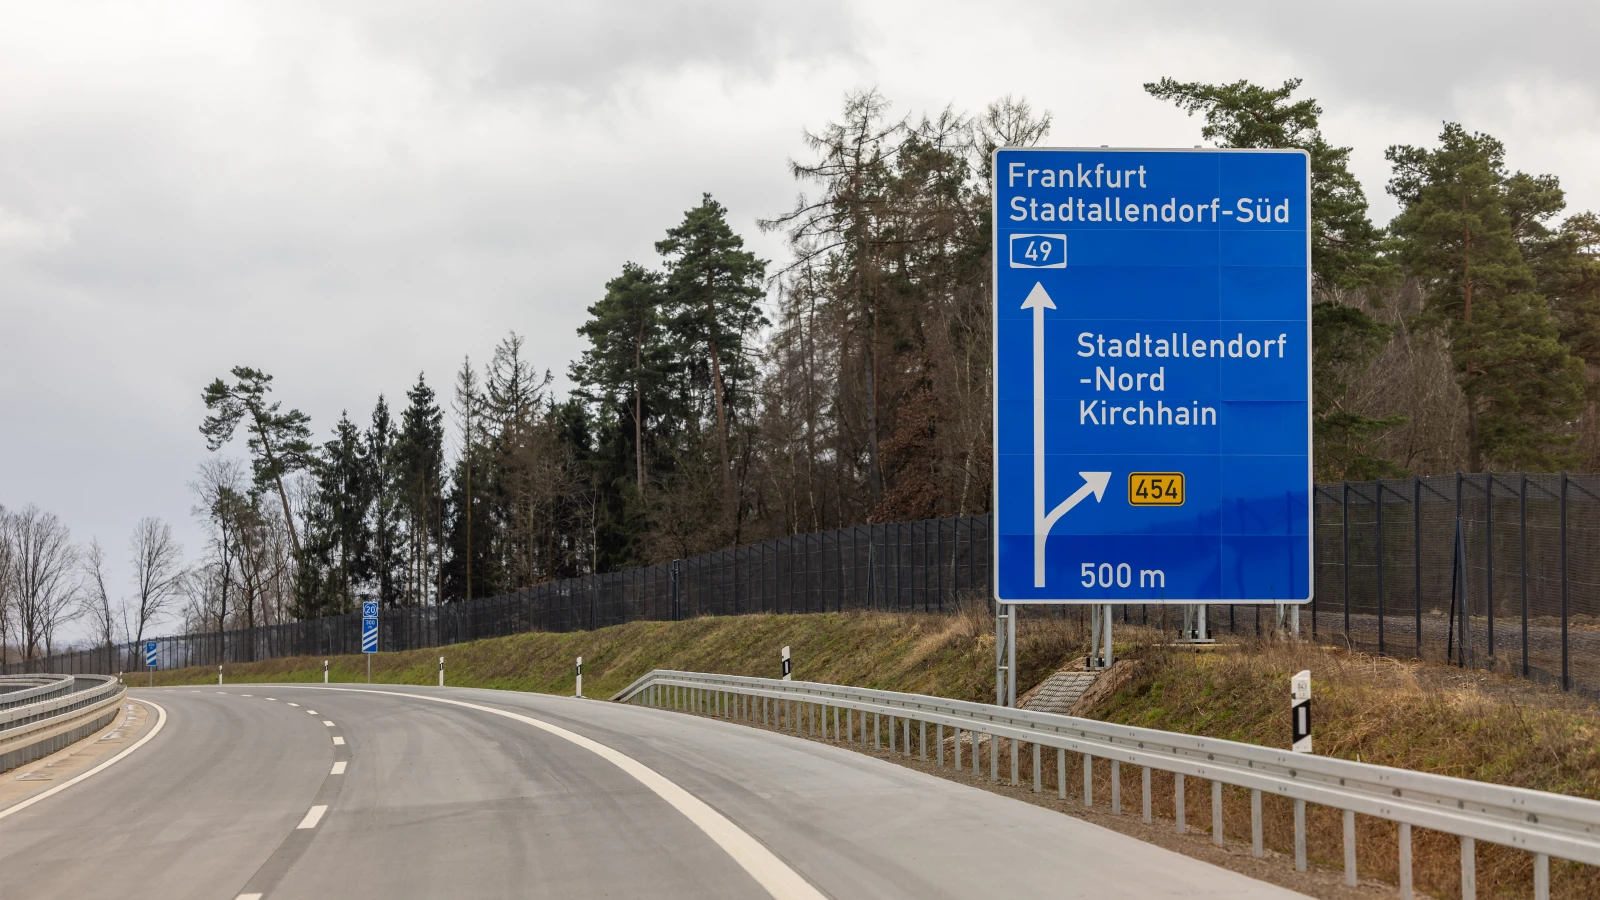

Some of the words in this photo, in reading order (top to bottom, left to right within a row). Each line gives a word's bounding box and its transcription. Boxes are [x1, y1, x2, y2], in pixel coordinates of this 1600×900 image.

[1008, 162, 1147, 189] Frankfurt
[1009, 196, 1290, 223] Stadtallendorf-Süd
[1024, 240, 1052, 262] 49
[1077, 332, 1287, 358] Stadtallendorf
[1080, 366, 1165, 392] -Nord
[1080, 400, 1217, 426] Kirchhain
[1135, 479, 1178, 499] 454
[1081, 562, 1132, 588] 500
[1140, 568, 1165, 588] m
[366, 606, 376, 614] 20
